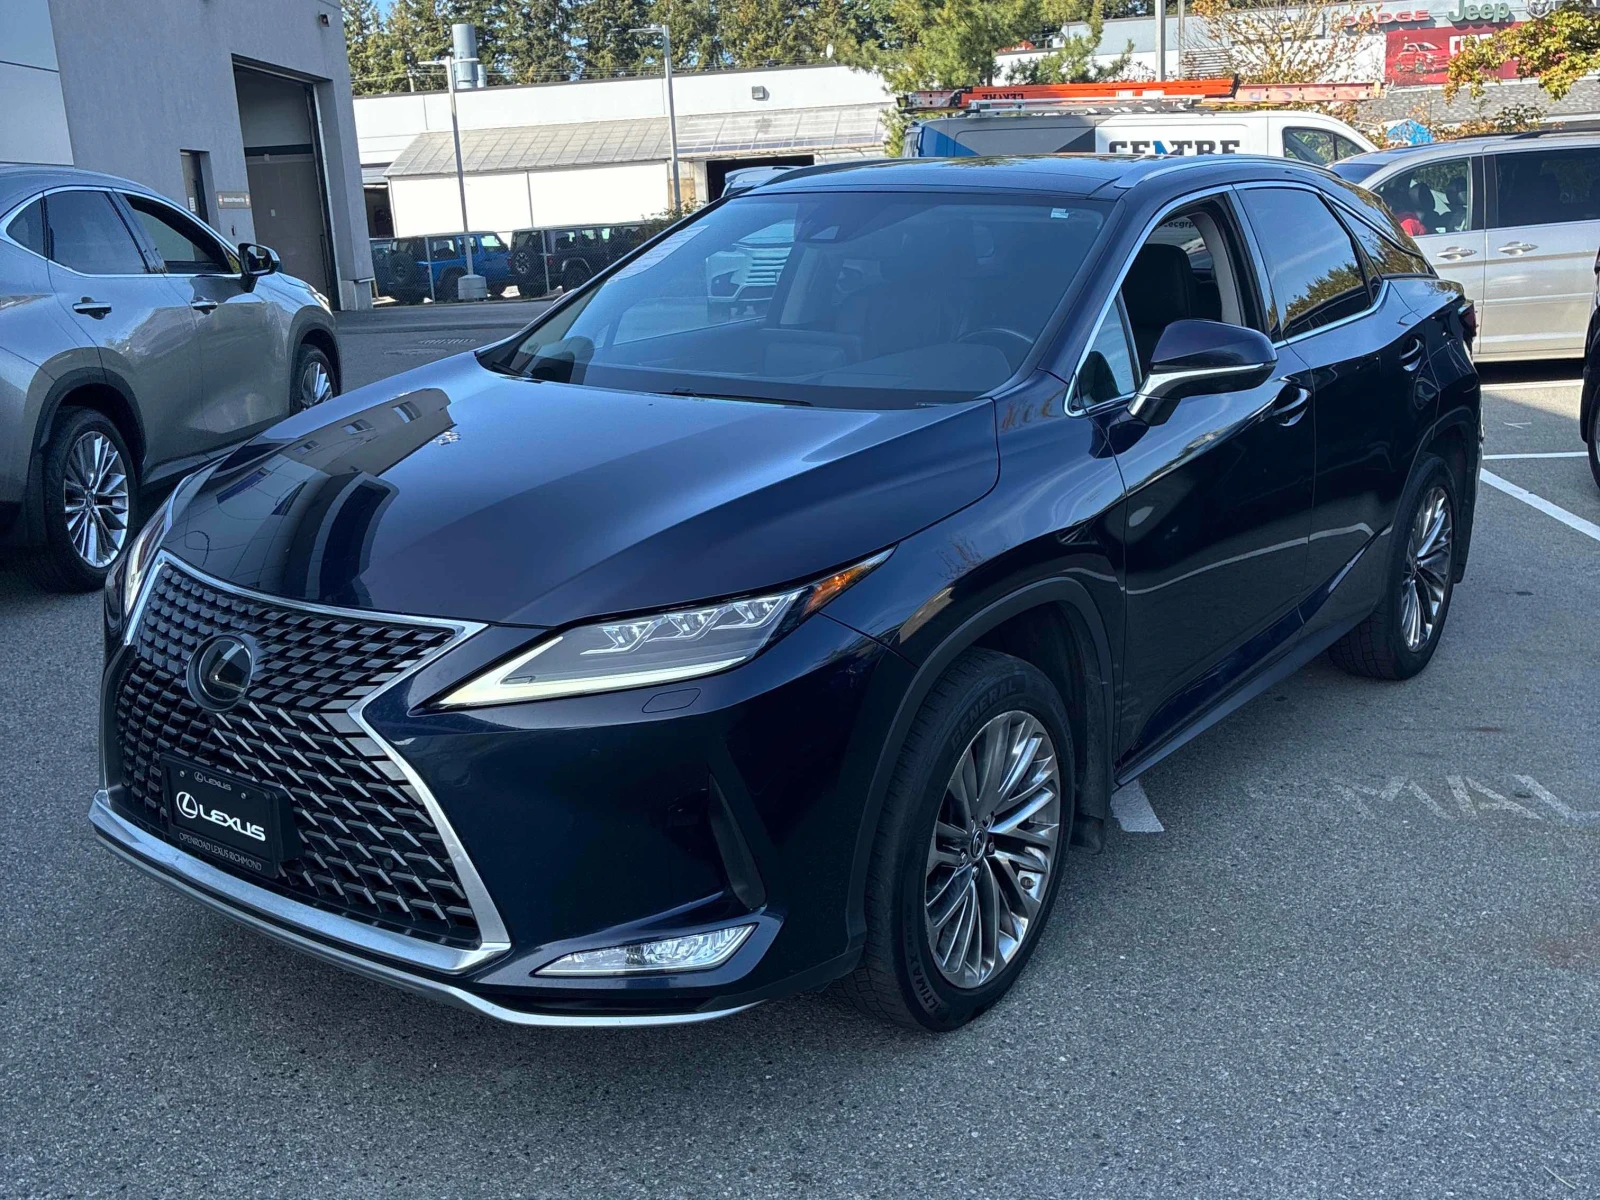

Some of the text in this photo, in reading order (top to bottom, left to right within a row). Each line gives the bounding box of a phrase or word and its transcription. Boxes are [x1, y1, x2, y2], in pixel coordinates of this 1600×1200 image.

[1447, 0, 1510, 23] Jeep
[950, 680, 1017, 750] GENERAL
[203, 776, 232, 791] LEXUS
[199, 803, 266, 842] LEXUS
[179, 832, 211, 851] OPENROAD
[211, 845, 229, 858] LEXUS
